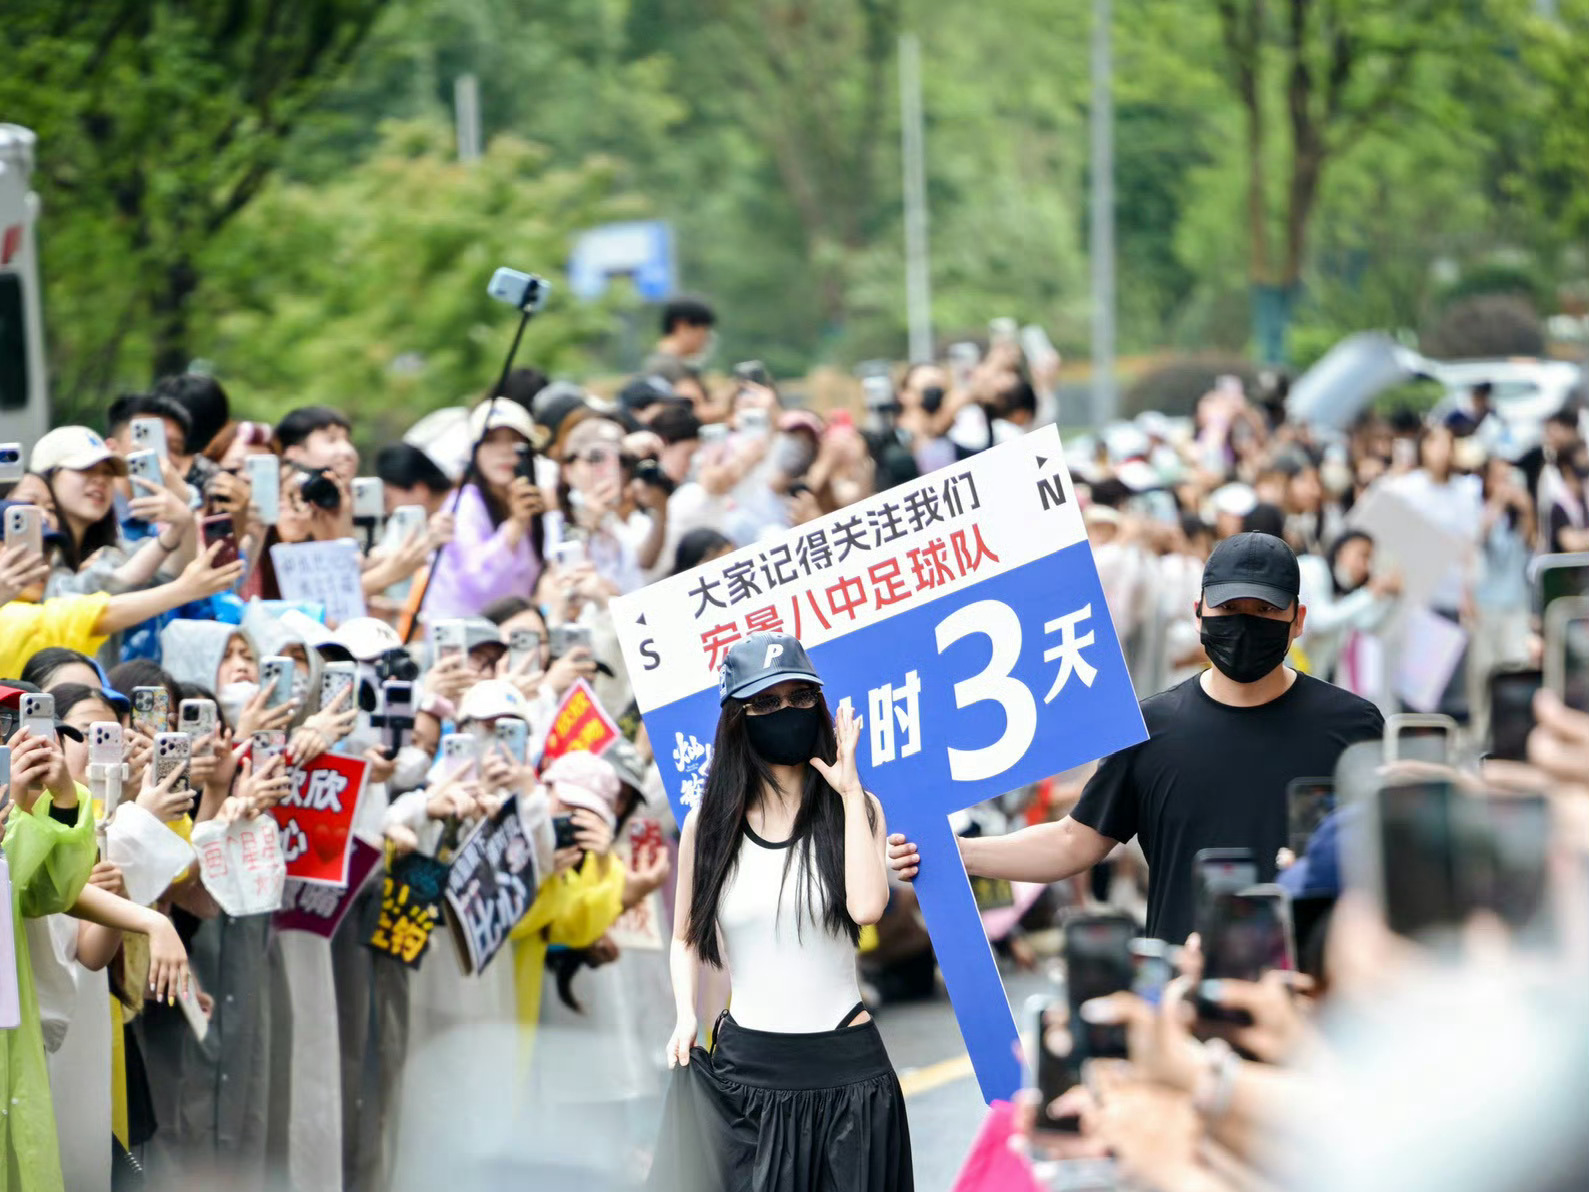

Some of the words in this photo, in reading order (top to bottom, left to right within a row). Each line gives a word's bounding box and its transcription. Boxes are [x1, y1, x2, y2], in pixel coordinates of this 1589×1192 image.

[1038, 474, 1067, 511] N
[687, 471, 981, 619] 大家记得关注我们
[639, 637, 661, 671] S
[763, 643, 784, 669] P
